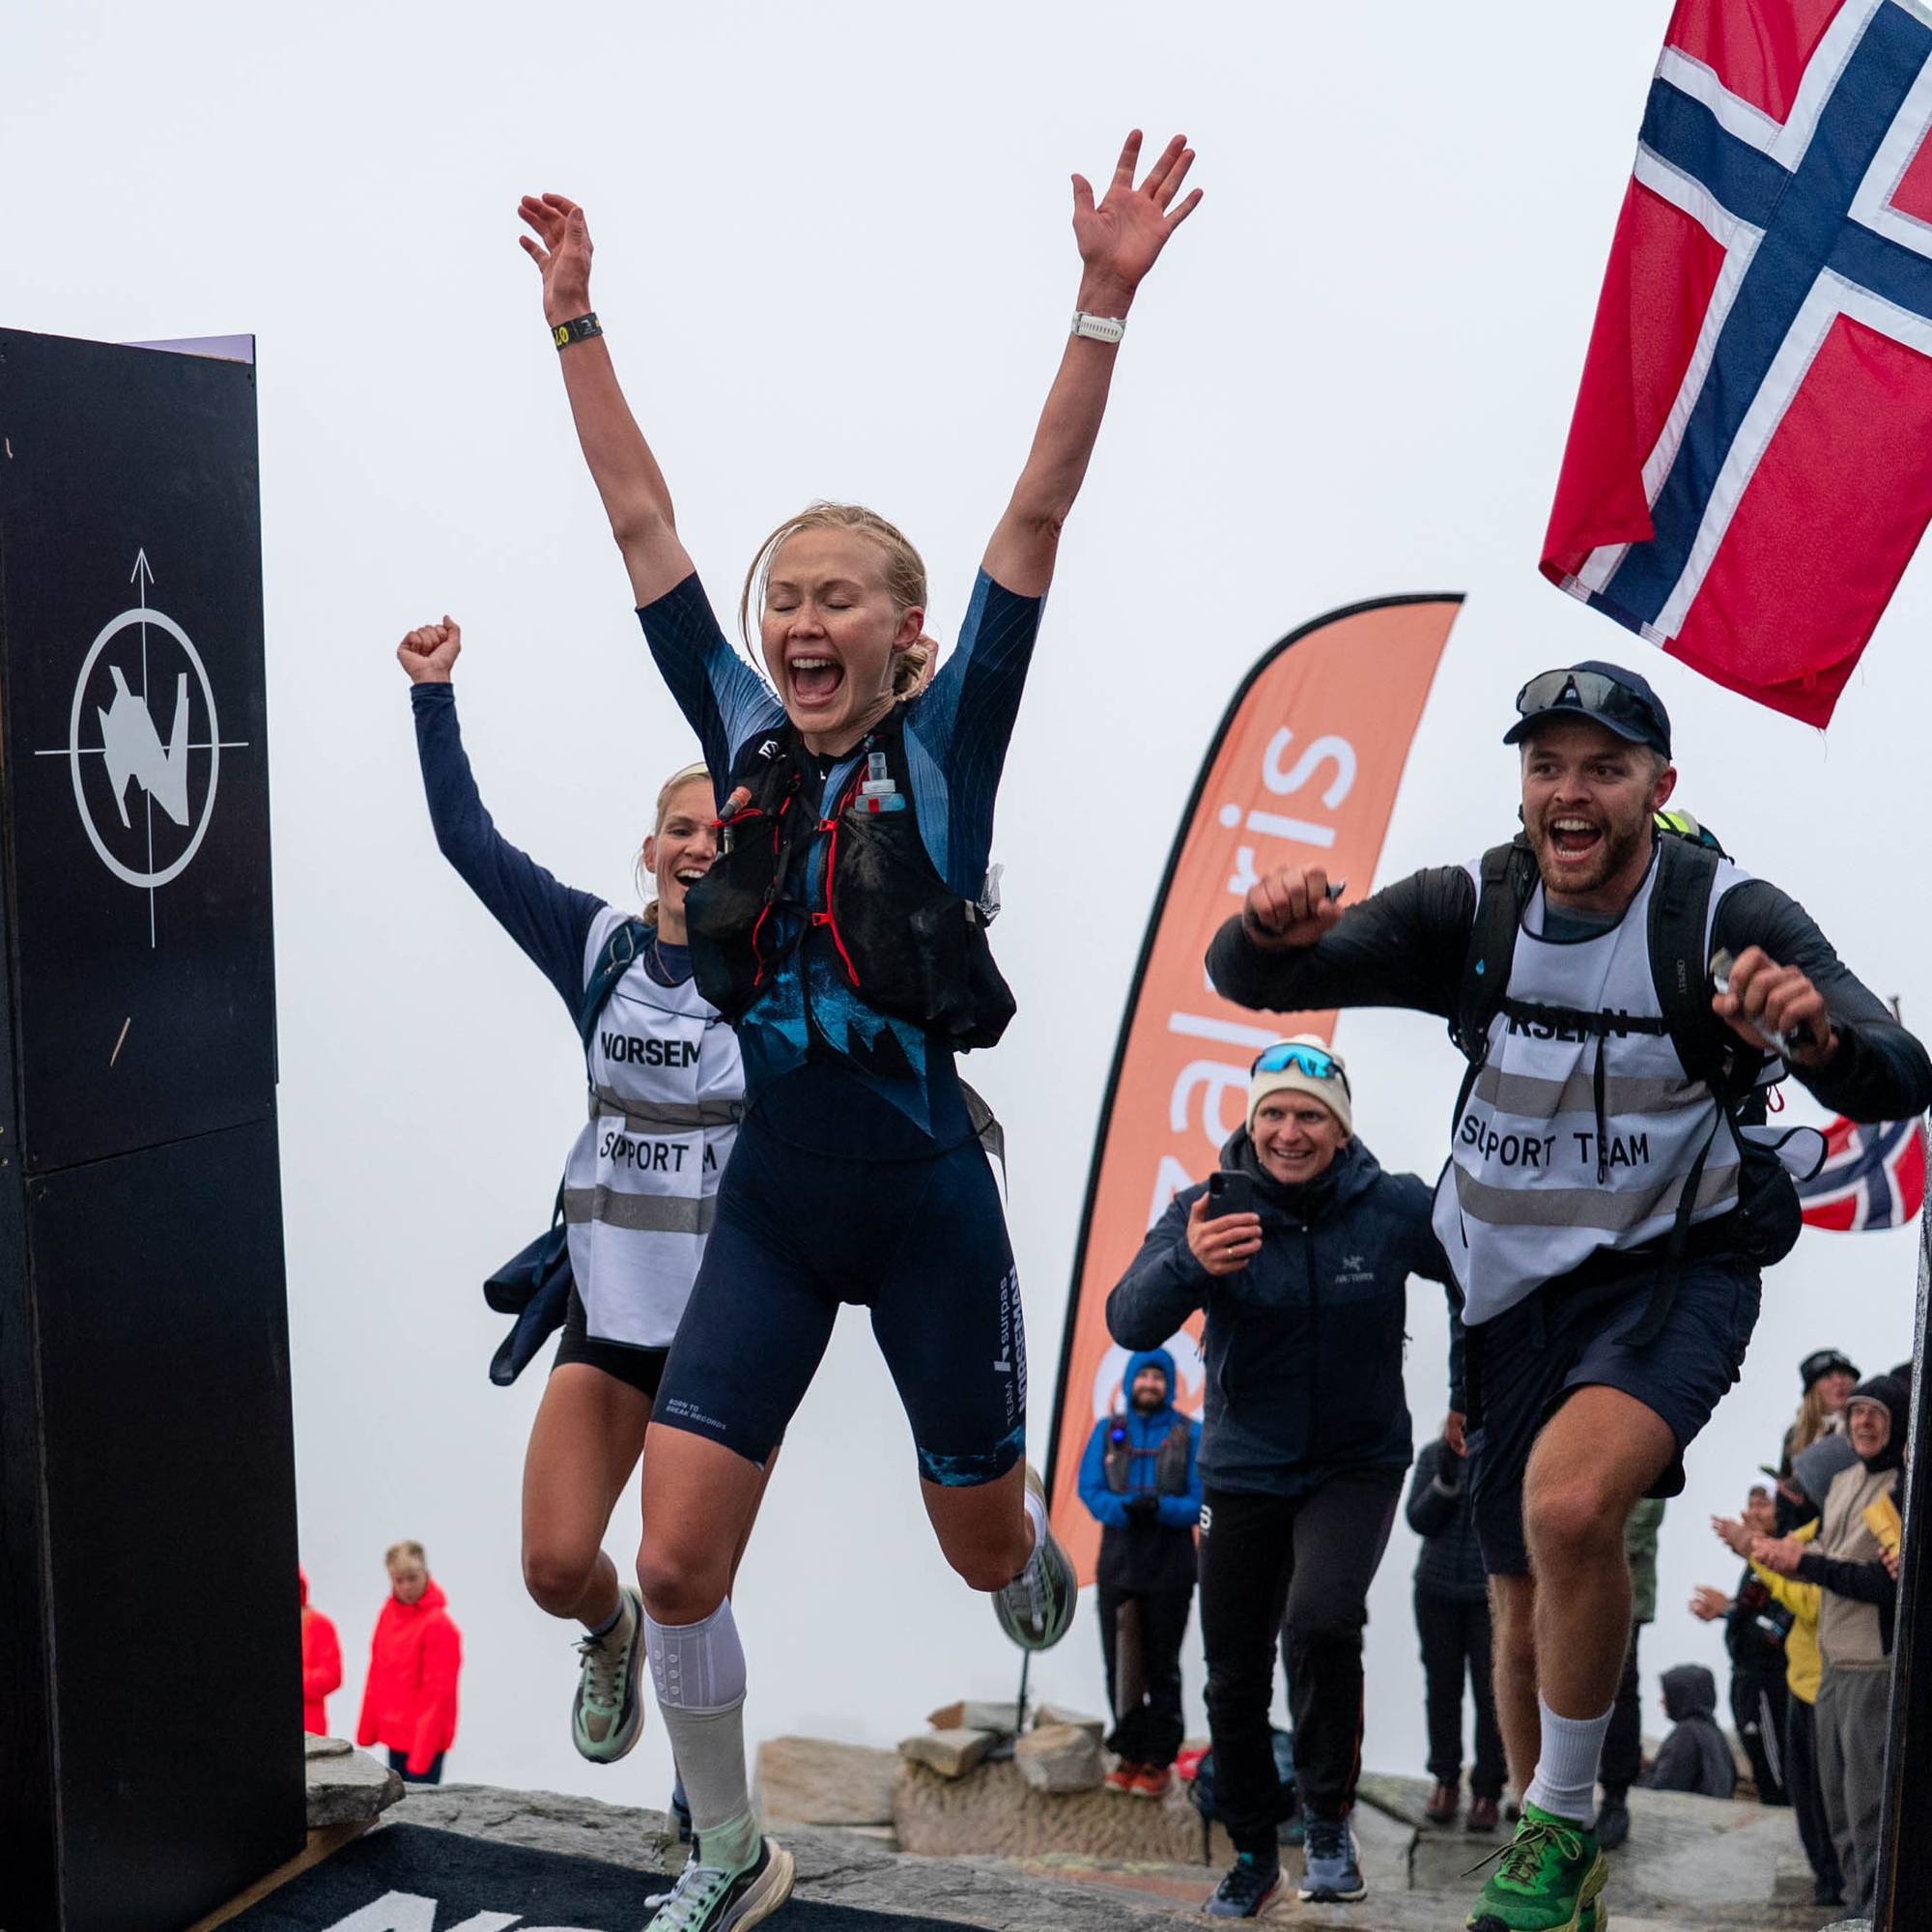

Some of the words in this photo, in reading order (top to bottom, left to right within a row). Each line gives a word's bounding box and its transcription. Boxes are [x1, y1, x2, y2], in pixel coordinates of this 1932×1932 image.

[1574, 1133, 1649, 1167] TAM
[668, 1398, 689, 1408] BORN
[690, 1404, 699, 1412] TO
[666, 1406, 689, 1417] BREAK
[690, 1413, 726, 1430] RECORDS
